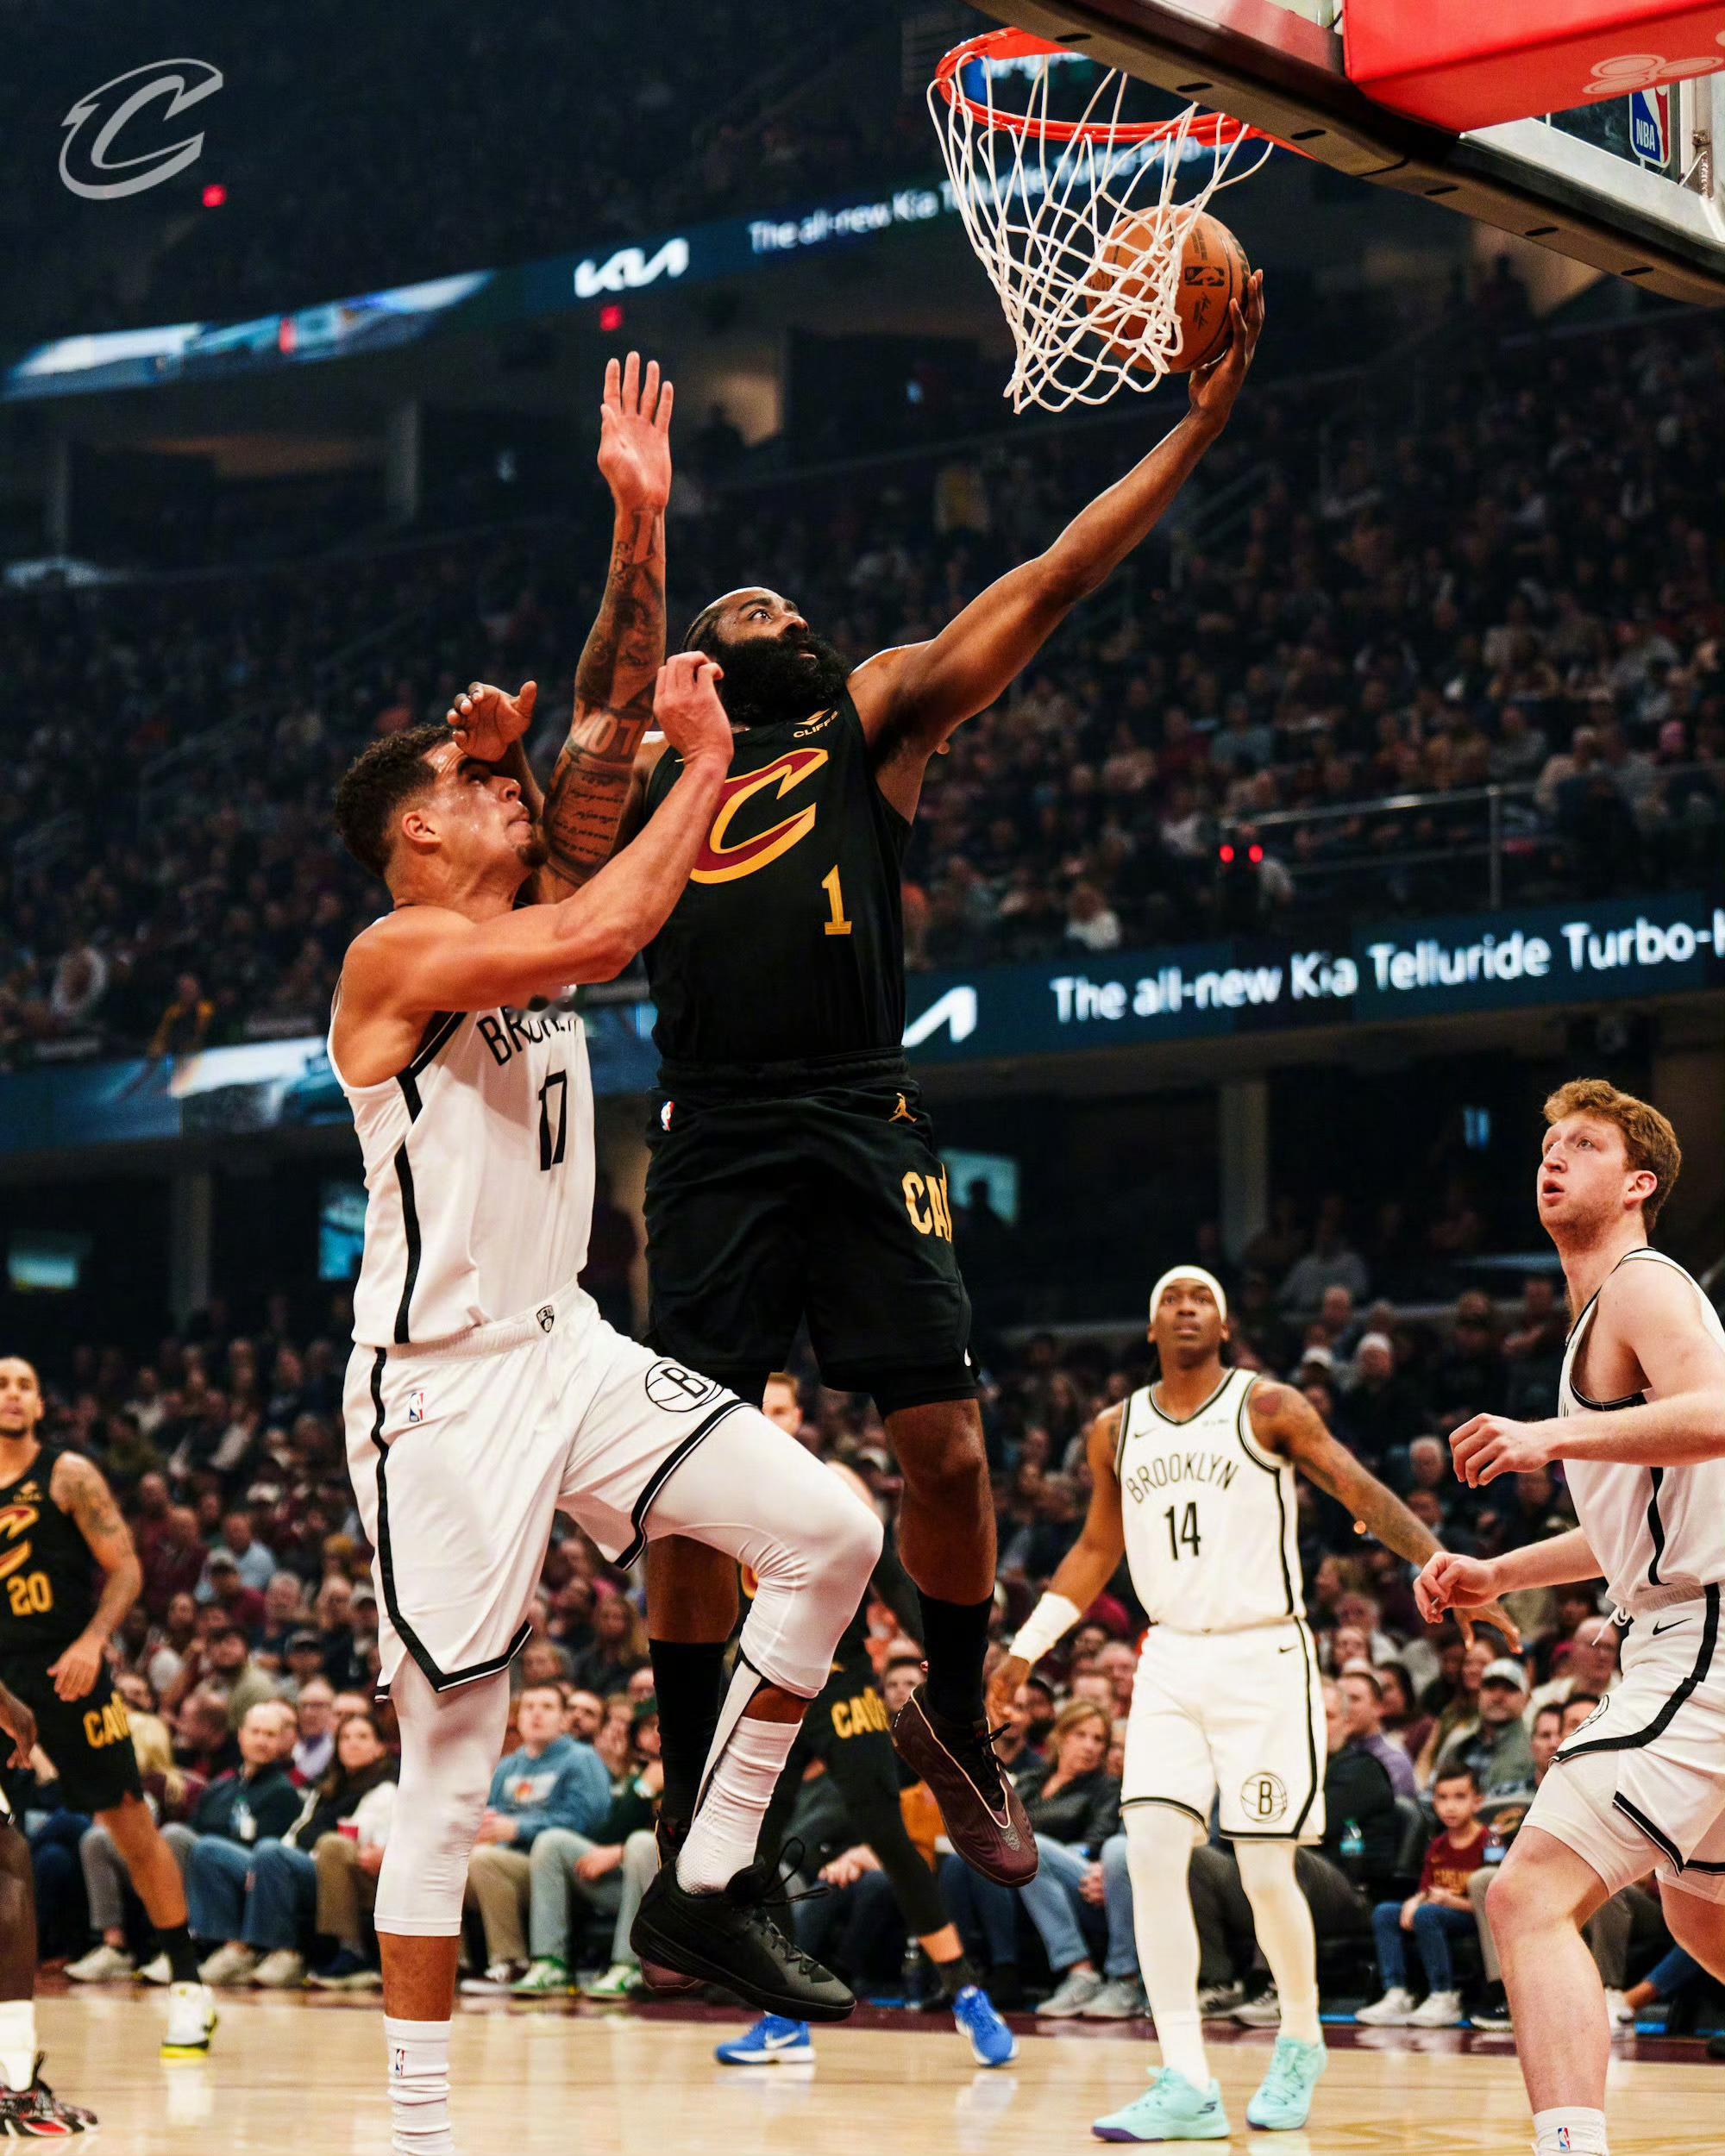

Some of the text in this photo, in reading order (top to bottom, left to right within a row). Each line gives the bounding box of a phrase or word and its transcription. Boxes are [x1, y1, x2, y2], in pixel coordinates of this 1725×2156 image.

[1635, 118, 1656, 153] NBA
[748, 220, 799, 254] The
[893, 190, 938, 222] Kia
[689, 747, 829, 884] C
[821, 864, 852, 935] 1
[1049, 975, 1126, 1024] The
[1133, 965, 1283, 1017] all-new
[1291, 950, 1359, 1000] Kia
[1367, 930, 1551, 992] Telluride
[660, 1367, 709, 1400] B
[1126, 1451, 1239, 1504] BROOKLYN
[1164, 1501, 1201, 1560] 14
[6, 1570, 53, 1616] 20
[1258, 1780, 1273, 1815] B
